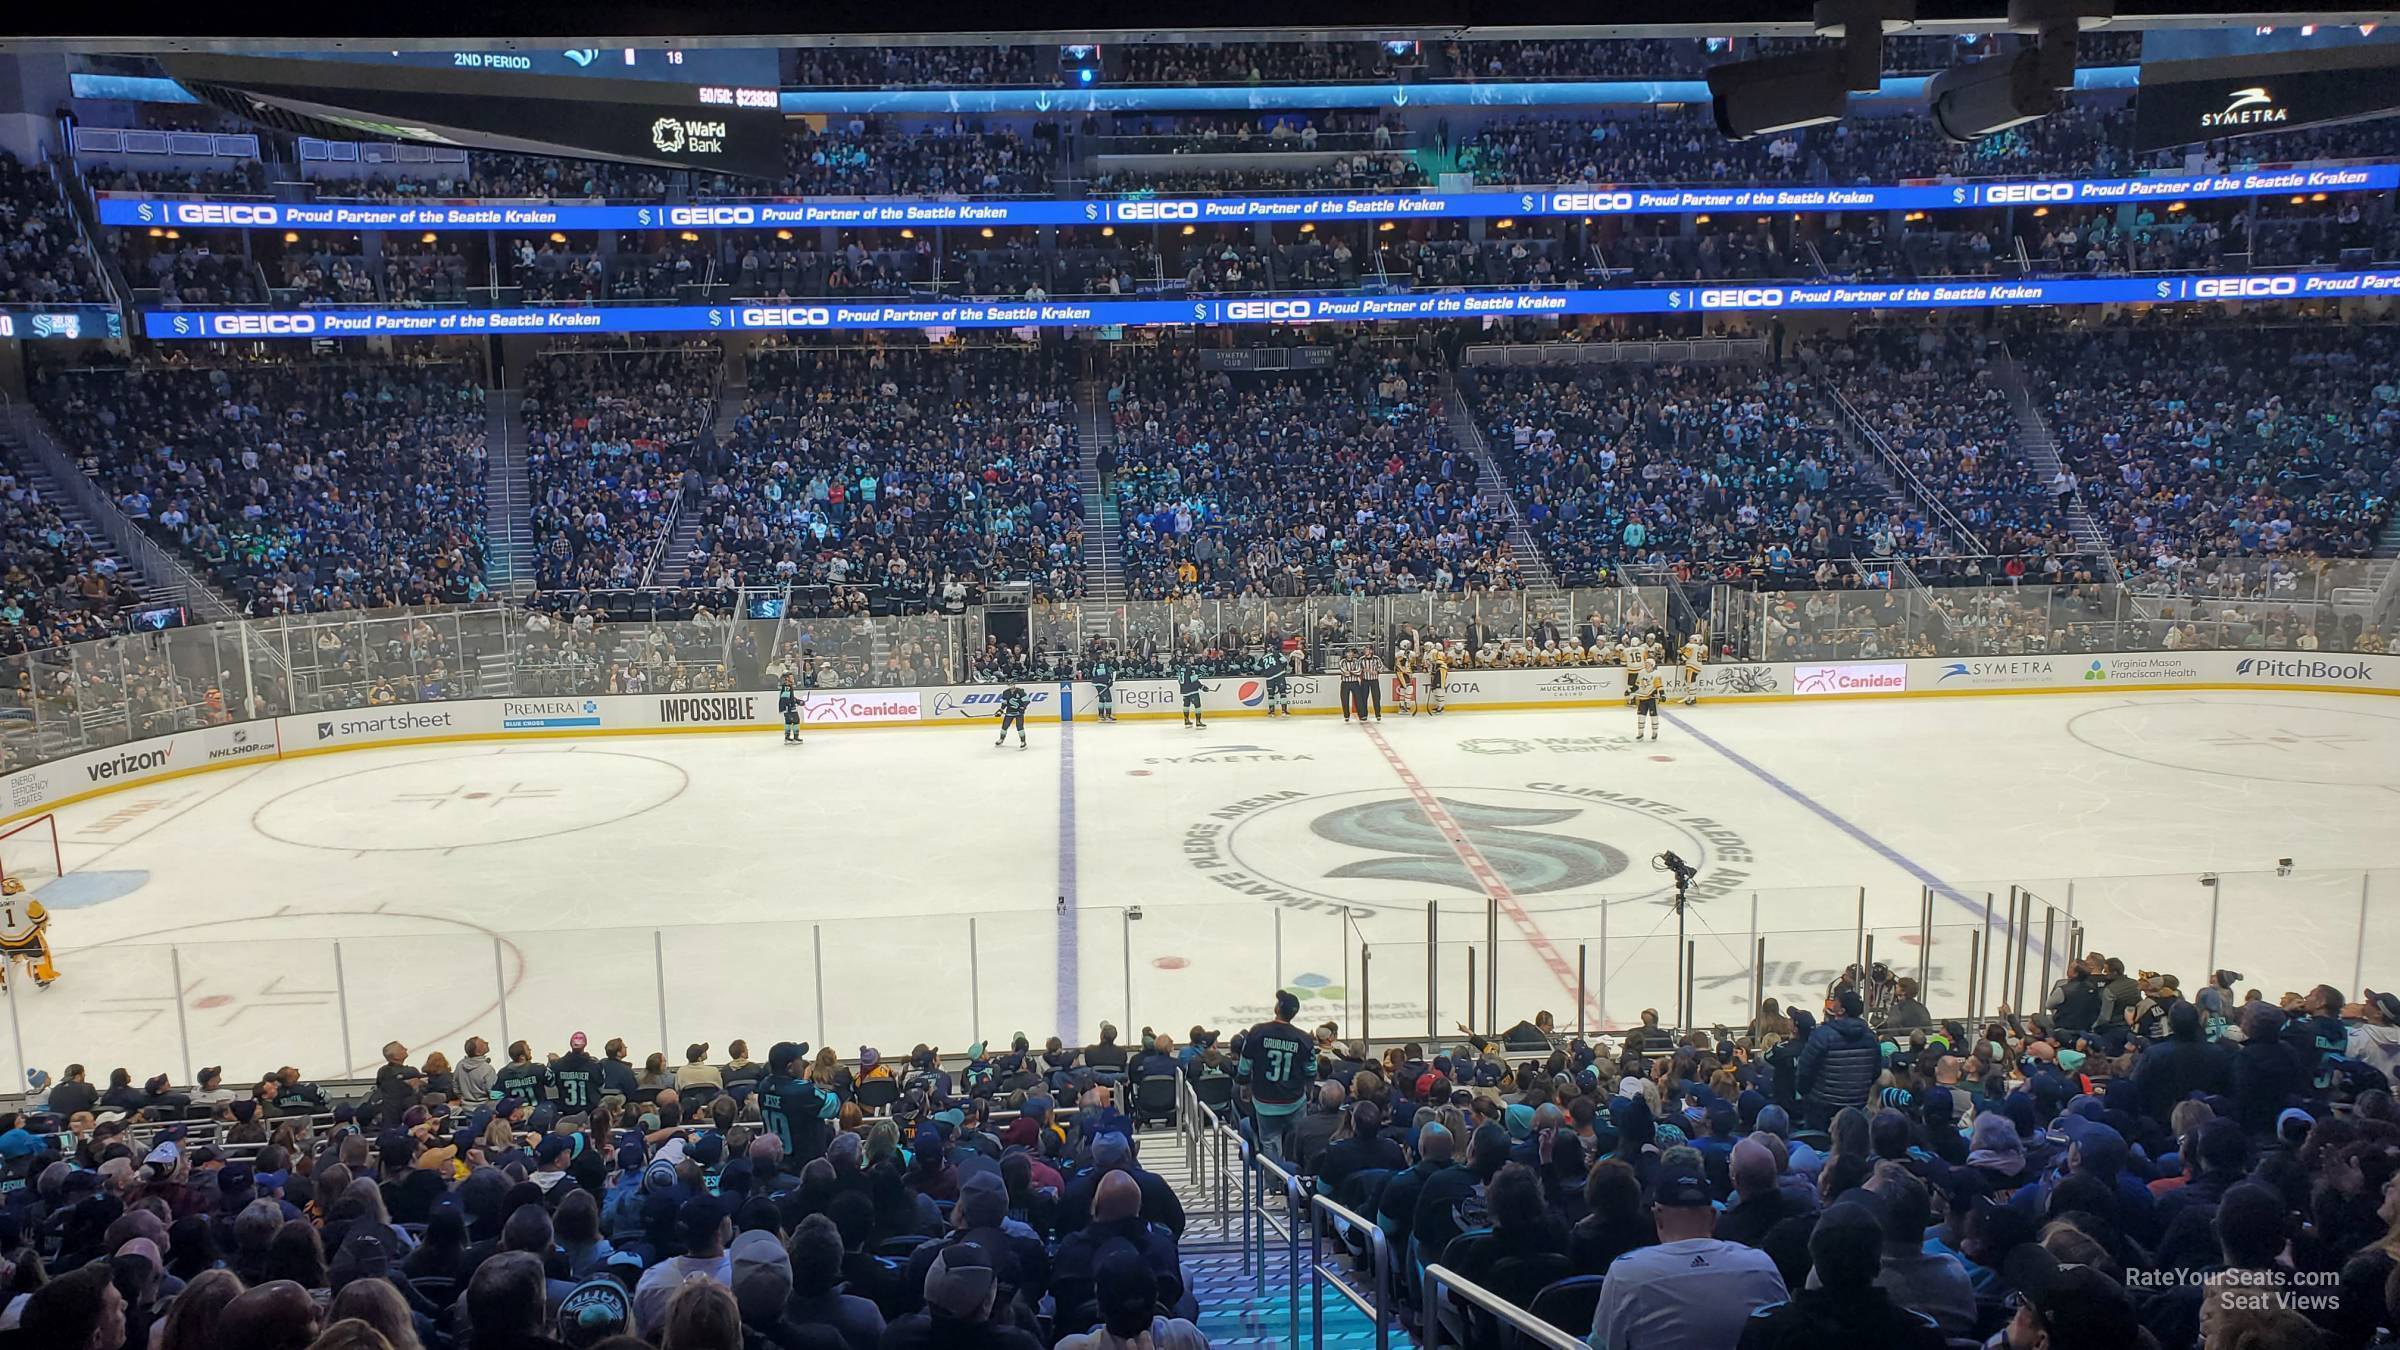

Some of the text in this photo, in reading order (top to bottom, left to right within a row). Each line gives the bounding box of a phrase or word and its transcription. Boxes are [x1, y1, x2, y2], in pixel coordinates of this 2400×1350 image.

[453, 52, 531, 70] 2ND PERIOD
[665, 51, 684, 66] 18
[2201, 108, 2289, 127] SYMETRA
[685, 121, 726, 138] WaFd
[689, 137, 723, 153] Bank
[1986, 170, 2369, 204] GEICO Proud Partner of the Seattle Kraken
[1117, 197, 1446, 220] GEICO Proud Partner of the Seattle Kraken
[1552, 190, 1875, 212] GEICO Proud Partner of the Seattle Kraken
[177, 203, 557, 225] GEICO Proud Partner of the Seattle Kraken
[670, 205, 1008, 226] GEICO Proud Partner of the Seattle Kraken
[2194, 276, 2298, 298] GEICO
[2304, 275, 2359, 291] Proud
[1700, 285, 2043, 308] GEICO Proud Partner of the Seattle Kraken
[742, 306, 1091, 327] GEICO Proud Partner of the Seattle Kraken
[1226, 295, 1567, 320] GEICO Proud Partner of the Seattle Kraken
[213, 312, 601, 335] GEICO Proud Partner of the Seattle Kraken
[1216, 351, 1249, 361] SYMETRA
[1223, 359, 1242, 367] CLUB
[1263, 655, 1277, 670] 24
[1973, 661, 2052, 675] SYMETRA
[2111, 658, 2182, 669] Virginia Mason
[2256, 659, 2373, 681] PitchBook
[1838, 674, 1903, 689] Canidae
[2111, 668, 2197, 679] Franciscan Health
[1273, 680, 1320, 698] epsi
[1422, 682, 1480, 694] TYOTA
[1666, 679, 1714, 688] KRAEN
[1115, 687, 1174, 709] Tegria
[504, 701, 576, 716] PREMERA
[660, 697, 755, 723] IMPOSSIBLE
[850, 702, 918, 718] Canidae
[340, 711, 452, 735] smartsheet
[505, 719, 521, 728] BLUE
[87, 748, 167, 782] verizon
[1144, 754, 1316, 765] SYMETRA
[1526, 781, 1688, 815] CLIMATE
[1680, 817, 1754, 863] PLEDGE
[1183, 790, 1377, 919] CLIMATE PLEDGE ARENA
[5, 908, 16, 928] 1
[1263, 1037, 1299, 1053] GRUBAUER
[1265, 1049, 1294, 1082] 31
[563, 1080, 588, 1106] 31
